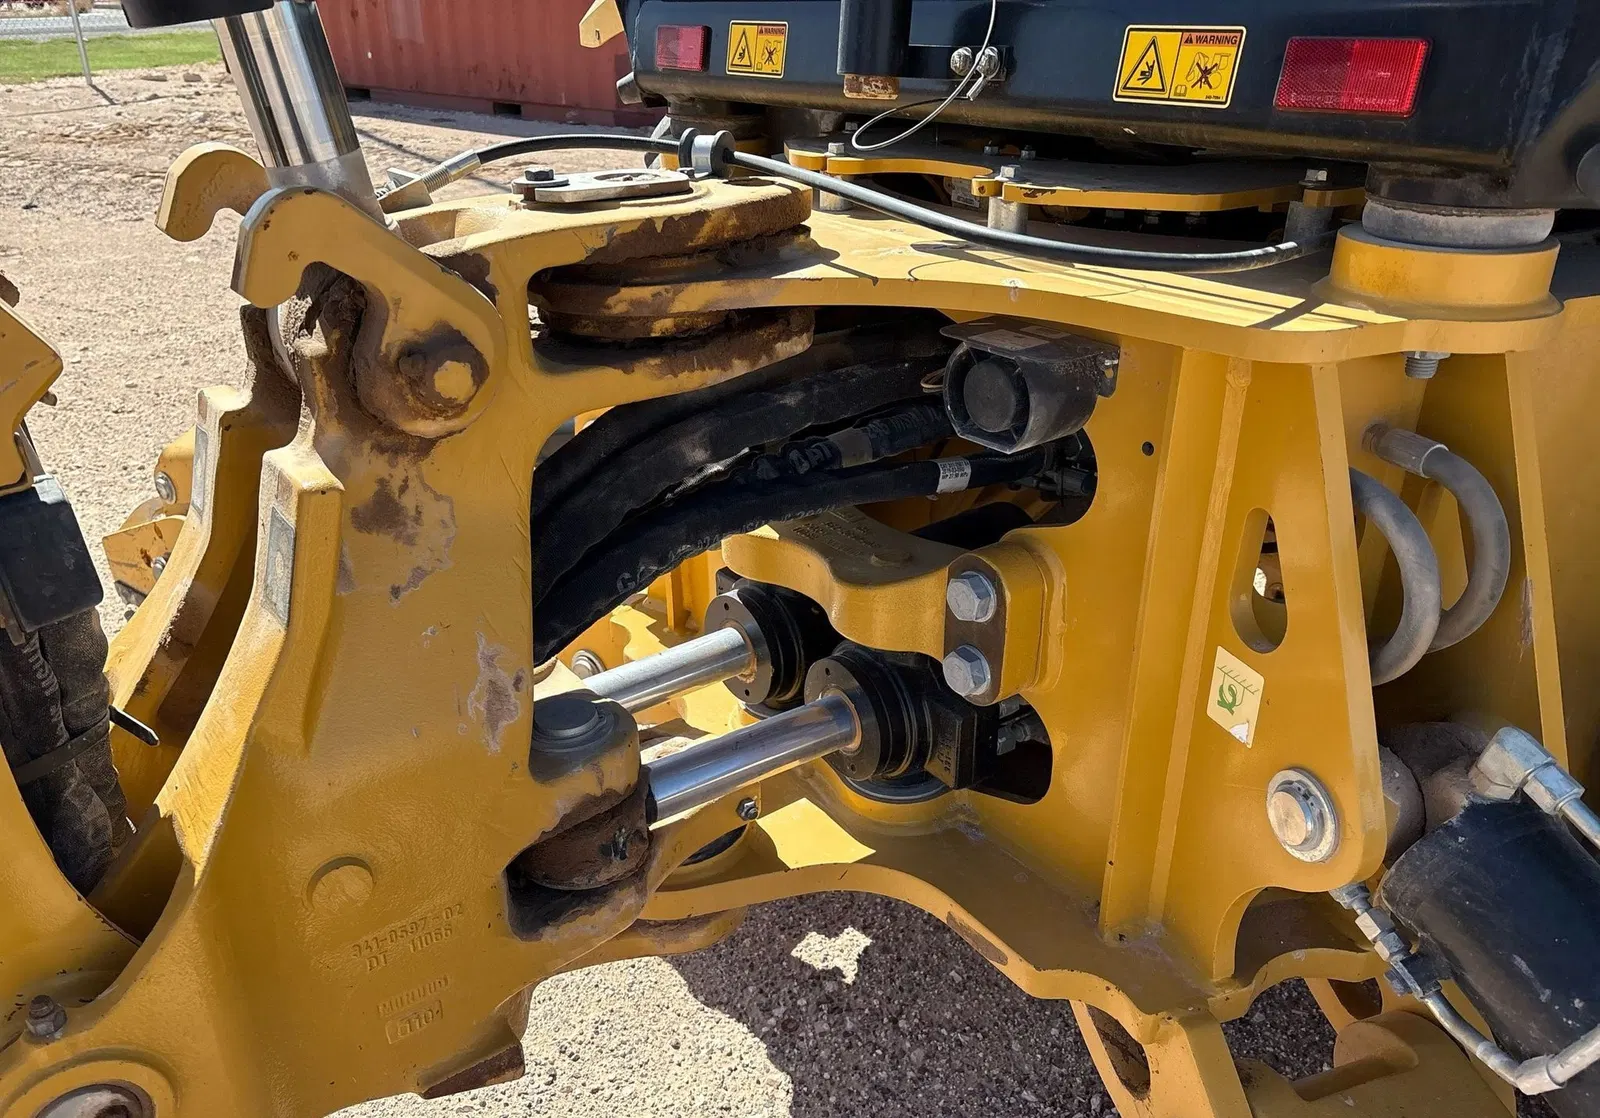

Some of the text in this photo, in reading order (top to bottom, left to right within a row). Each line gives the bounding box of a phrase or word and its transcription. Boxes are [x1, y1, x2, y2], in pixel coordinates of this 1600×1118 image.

[764, 27, 785, 35] WARNING
[1195, 34, 1238, 45] WARNING
[365, 950, 388, 972] DT
